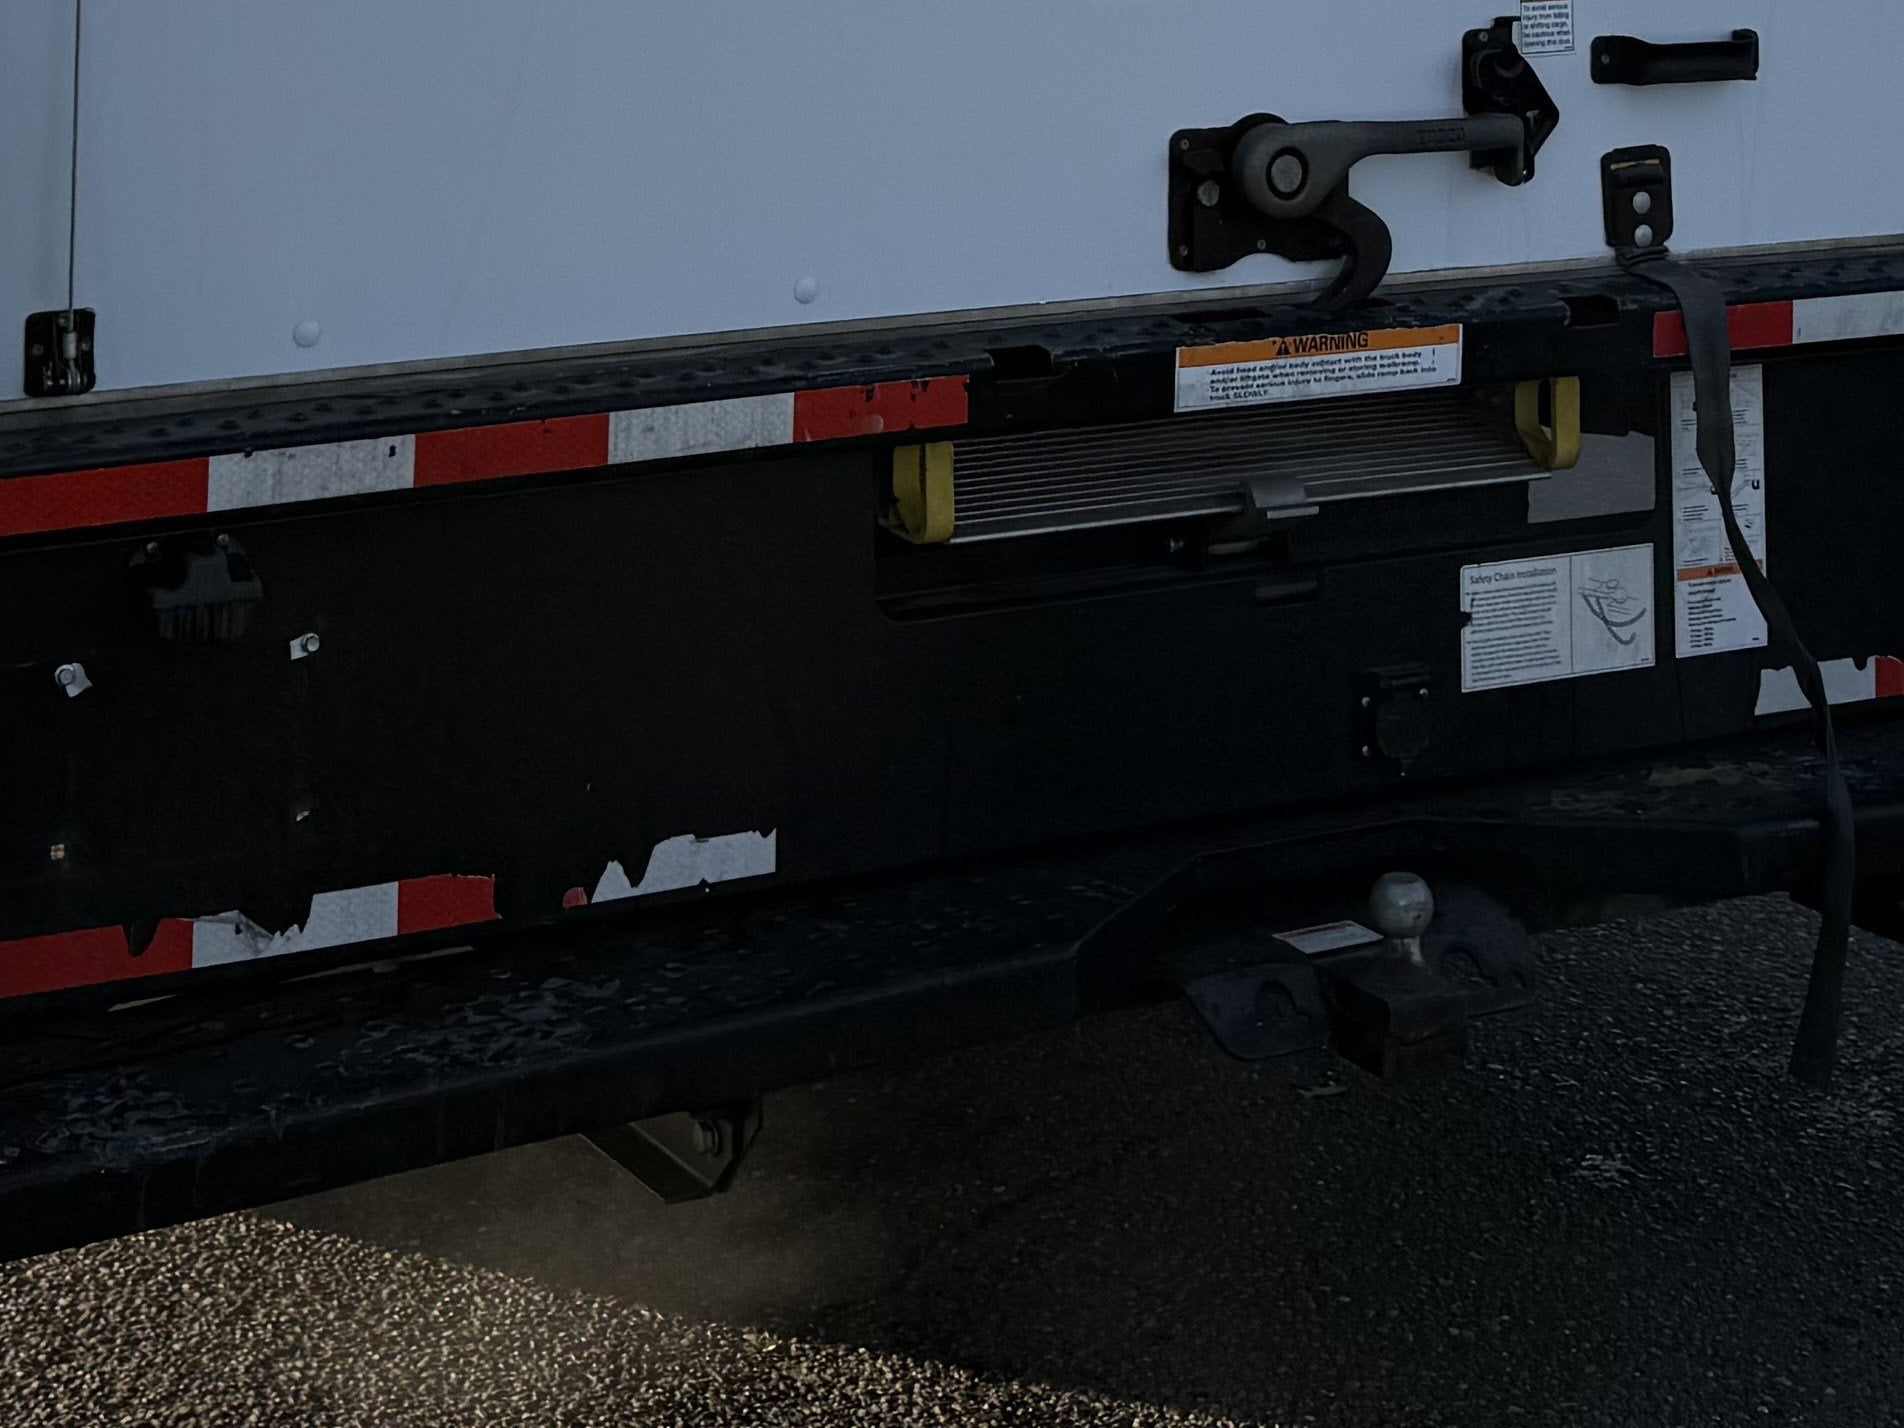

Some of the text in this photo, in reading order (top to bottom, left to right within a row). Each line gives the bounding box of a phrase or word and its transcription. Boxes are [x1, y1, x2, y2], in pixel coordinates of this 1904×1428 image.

[1293, 332, 1369, 353] WARNING
[1210, 367, 1234, 376] Avoid
[1236, 366, 1257, 374] head
[1289, 361, 1309, 370] body
[1344, 356, 1362, 364] with
[1210, 376, 1238, 384] and/or
[1272, 371, 1295, 379] when
[1296, 367, 1336, 376] removing
[1348, 363, 1377, 372] storing
[1221, 383, 1254, 392] prevent
[1256, 381, 1285, 389] serious
[1287, 378, 1311, 386] injury
[1356, 371, 1375, 379] slide
[1377, 369, 1398, 377] ramp
[1400, 367, 1418, 375] back
[1209, 393, 1230, 401] truck
[1470, 574, 1492, 584] Safety
[1494, 572, 1516, 581] Chain
